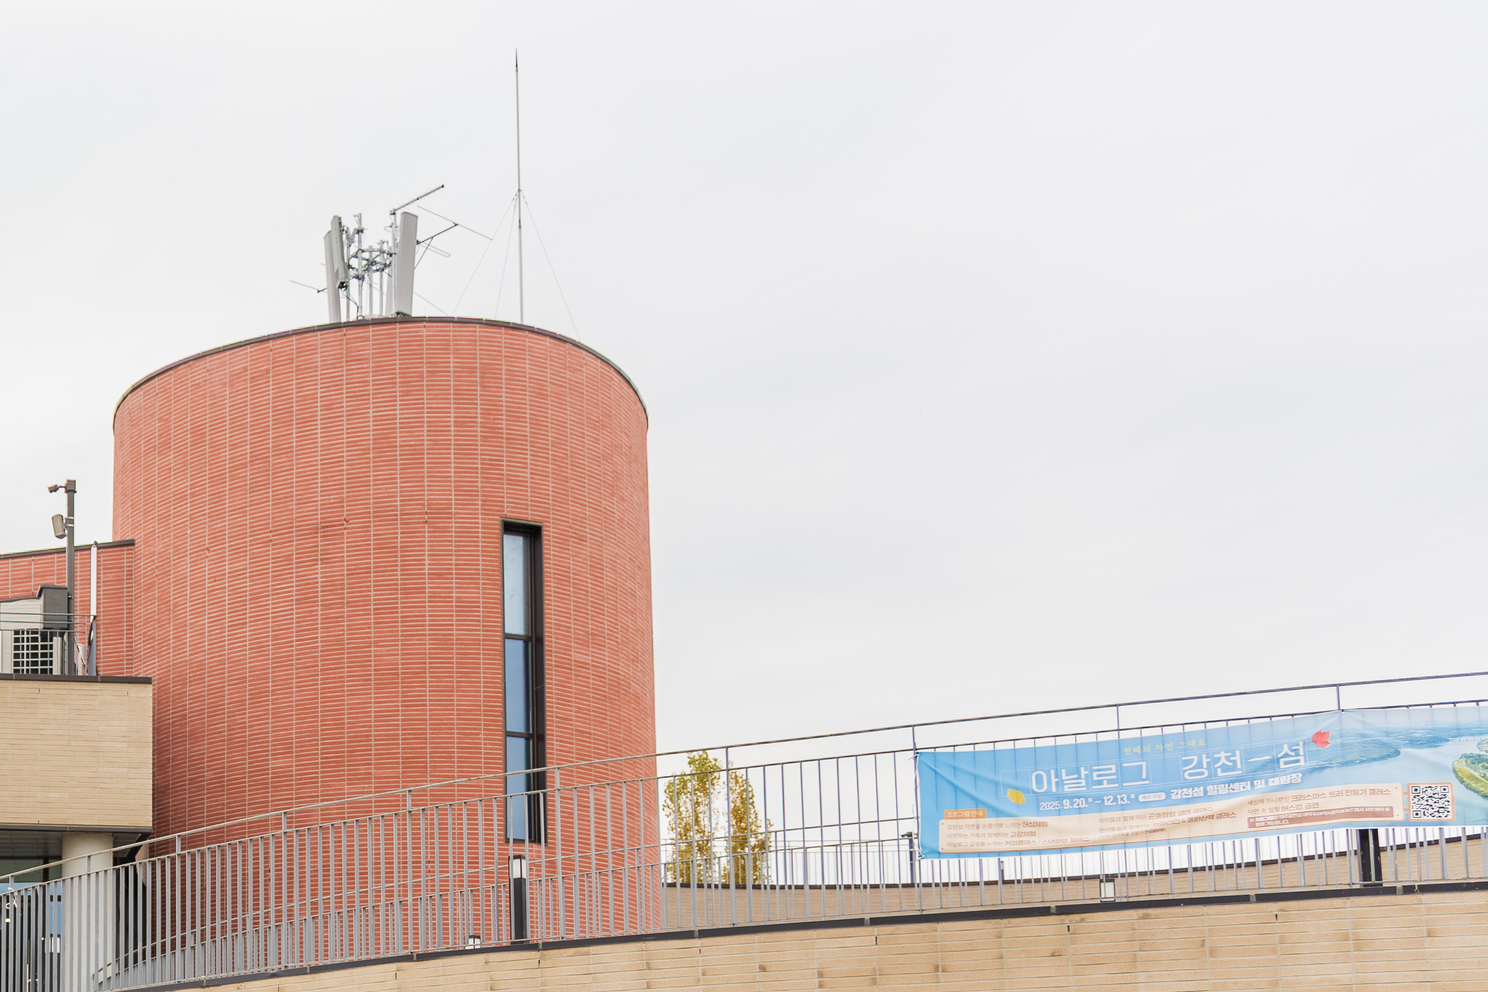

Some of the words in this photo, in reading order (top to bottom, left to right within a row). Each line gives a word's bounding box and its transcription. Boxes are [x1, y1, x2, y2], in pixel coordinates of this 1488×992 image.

[1155, 742, 1173, 752] 자연
[1177, 739, 1207, 749] 그대로
[1030, 761, 1150, 794] 아날로그
[1170, 785, 1204, 800] 강천섬
[1206, 781, 1252, 797] 힐링센터
[1253, 778, 1266, 790] 및
[1267, 772, 1303, 787] 캠핑장
[1291, 793, 1327, 802] 크리스마스
[1328, 790, 1344, 798] 트리
[1368, 788, 1392, 796] 클래스
[946, 811, 970, 819] 프로그램
[971, 810, 983, 818] 안내
